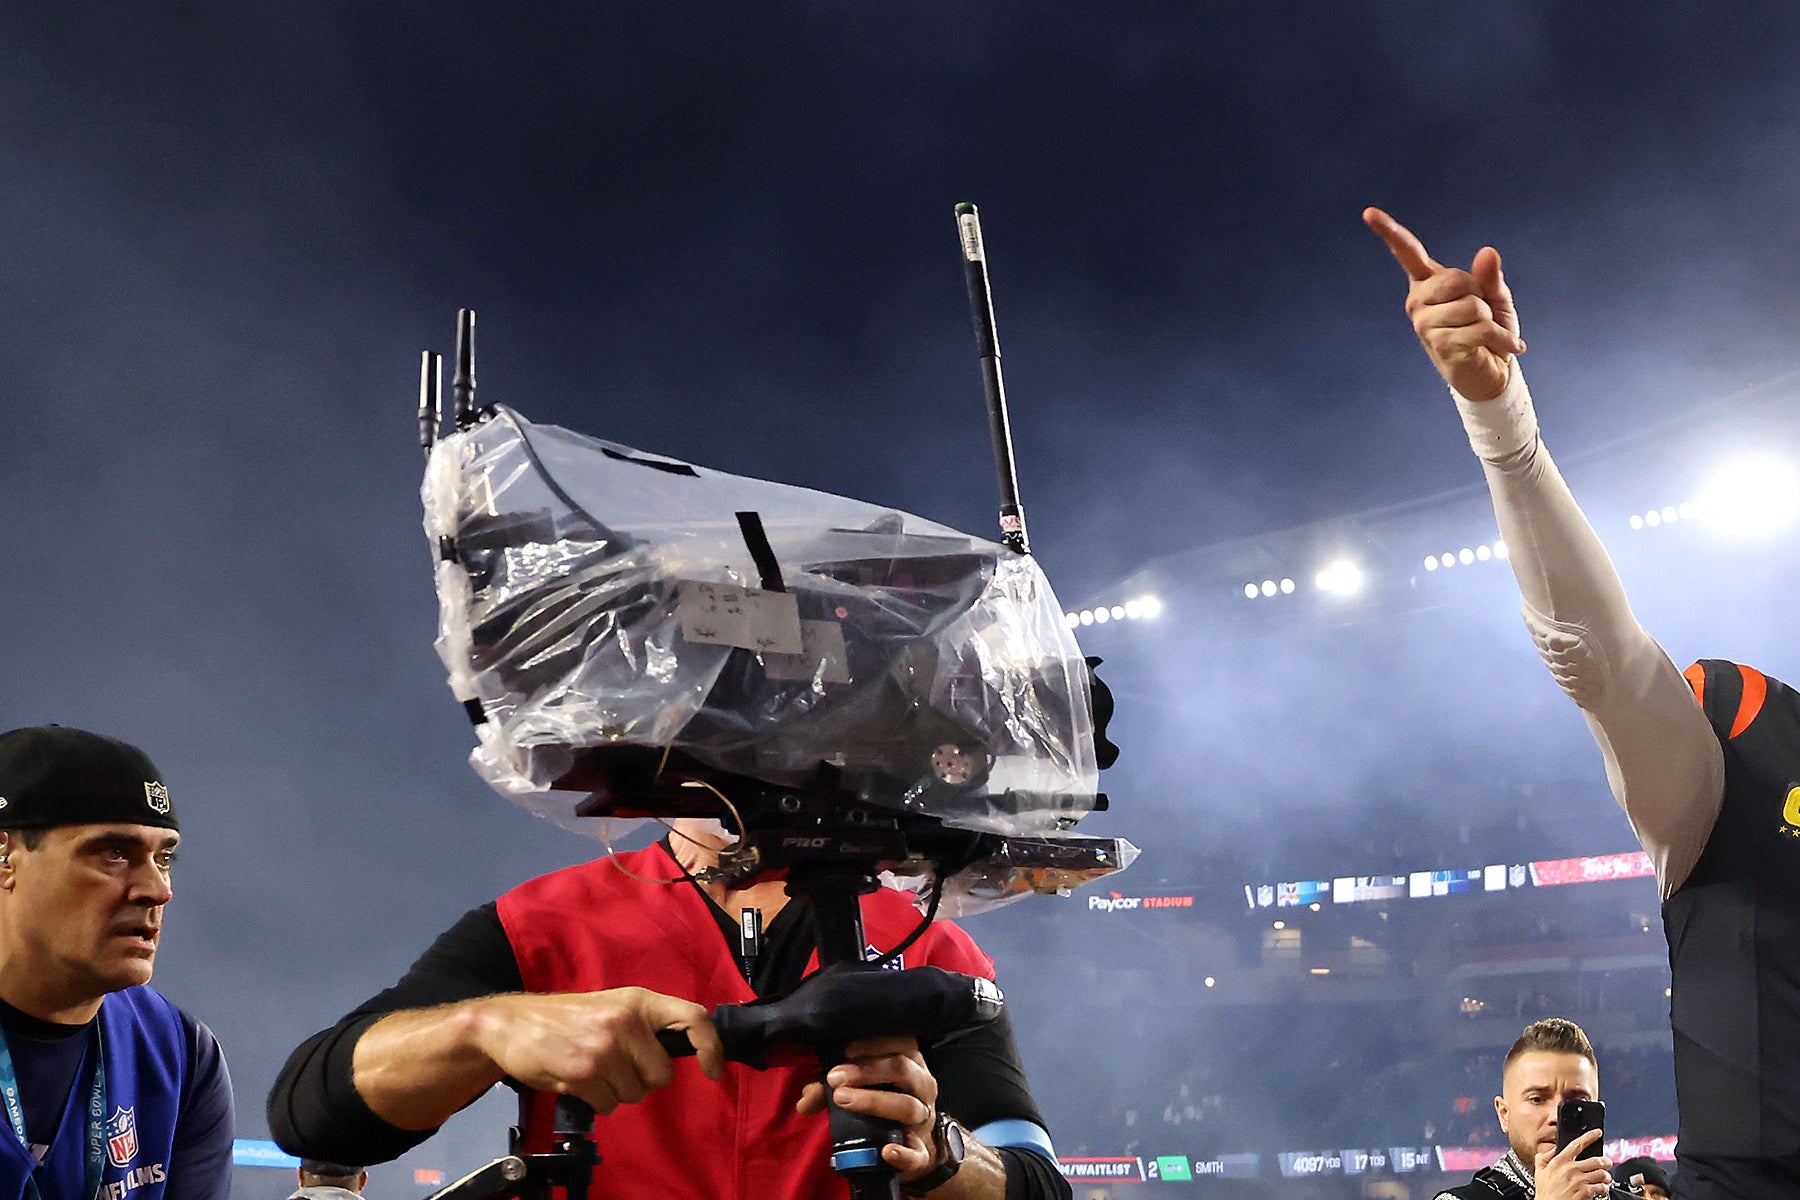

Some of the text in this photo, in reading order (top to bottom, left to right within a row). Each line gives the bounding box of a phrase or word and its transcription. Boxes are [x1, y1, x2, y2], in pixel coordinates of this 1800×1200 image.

[1088, 895, 1194, 913] Paycor STADIUM
[90, 1081, 103, 1164] SUPER BOWL
[127, 1163, 166, 1191] ILMS
[1148, 1161, 1158, 1179] 2
[1195, 1161, 1224, 1174] SMITH
[1293, 1154, 1325, 1174] 4097
[1354, 1153, 1368, 1170] 17
[1401, 1151, 1415, 1169] 15
